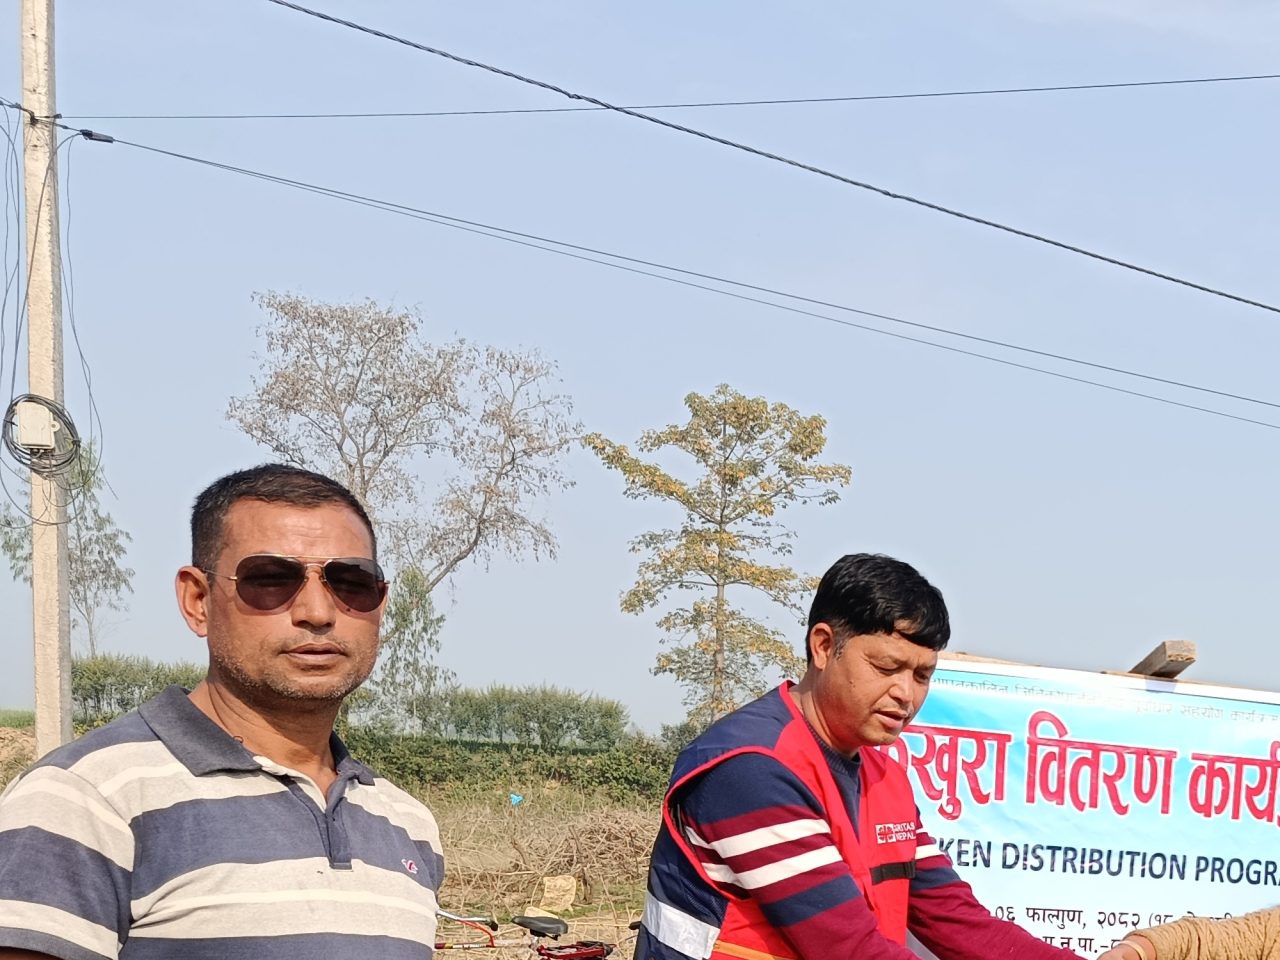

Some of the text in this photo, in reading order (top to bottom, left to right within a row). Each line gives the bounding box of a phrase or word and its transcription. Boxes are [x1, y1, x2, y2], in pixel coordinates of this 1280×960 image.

[1026, 711, 1177, 815] वितरण
[895, 831, 917, 841] NEPAL
[938, 838, 992, 868] KEN
[1002, 842, 1186, 880] DISTRIBUTION
[1026, 907, 1086, 930] फाल्गुण,
[1097, 911, 1141, 930] २०८२
